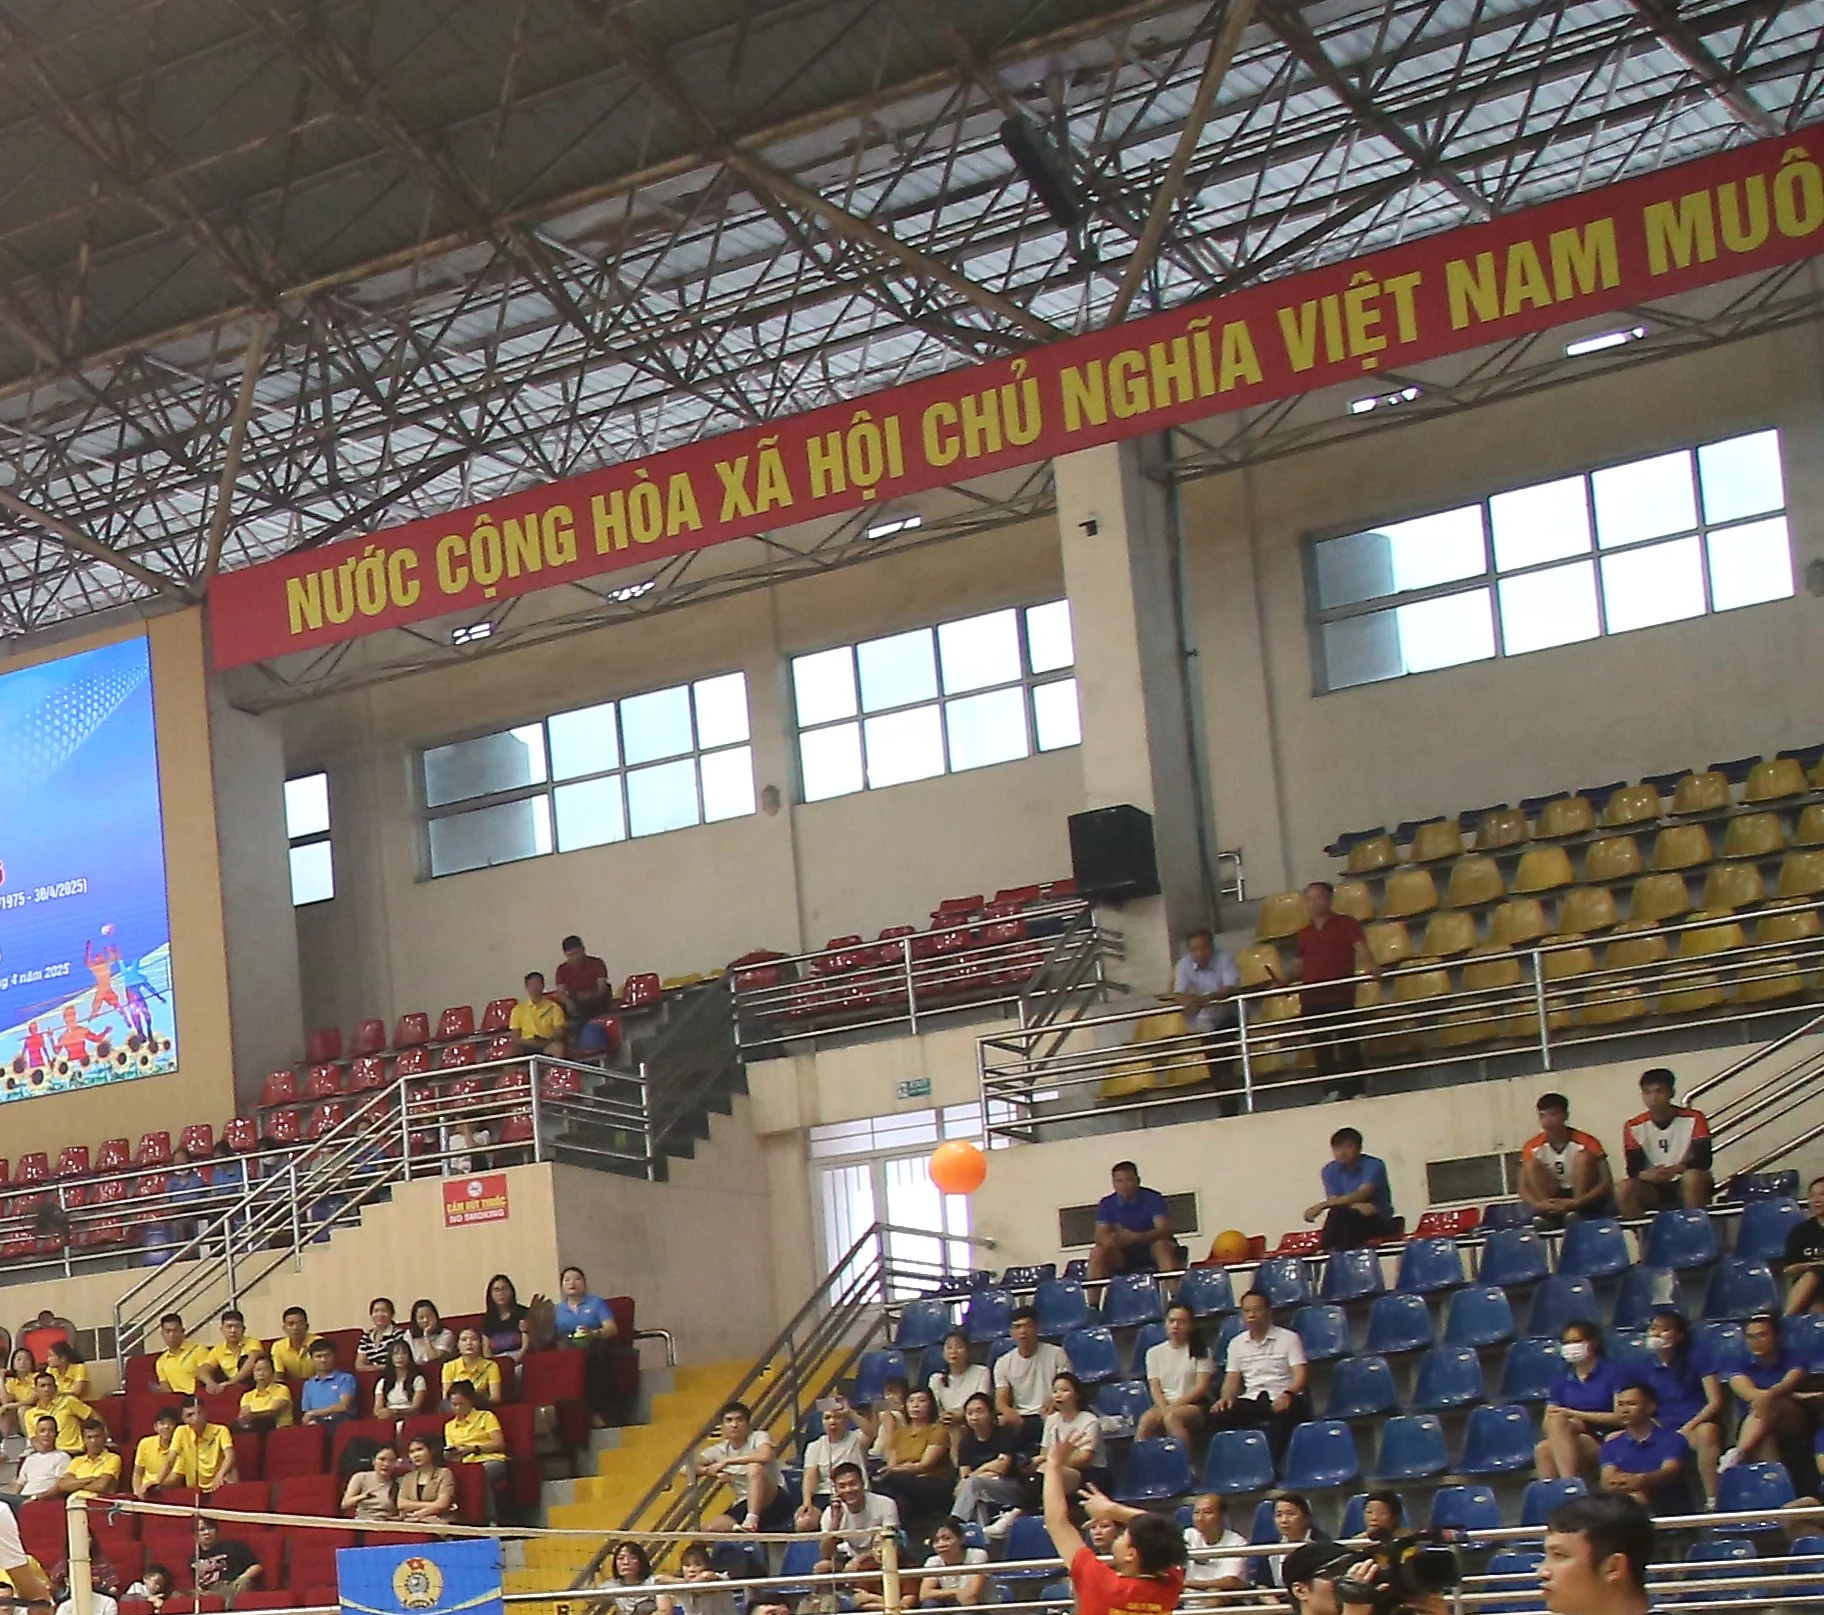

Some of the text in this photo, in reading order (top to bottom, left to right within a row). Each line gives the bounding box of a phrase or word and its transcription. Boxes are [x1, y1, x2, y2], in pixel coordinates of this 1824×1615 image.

[286, 146, 1824, 635] NƯỚC CỘNG HÒA XÃ HỘI CHỦ NGHĨA VIỆT NAM MUÔ
[44, 962, 71, 981] 2025
